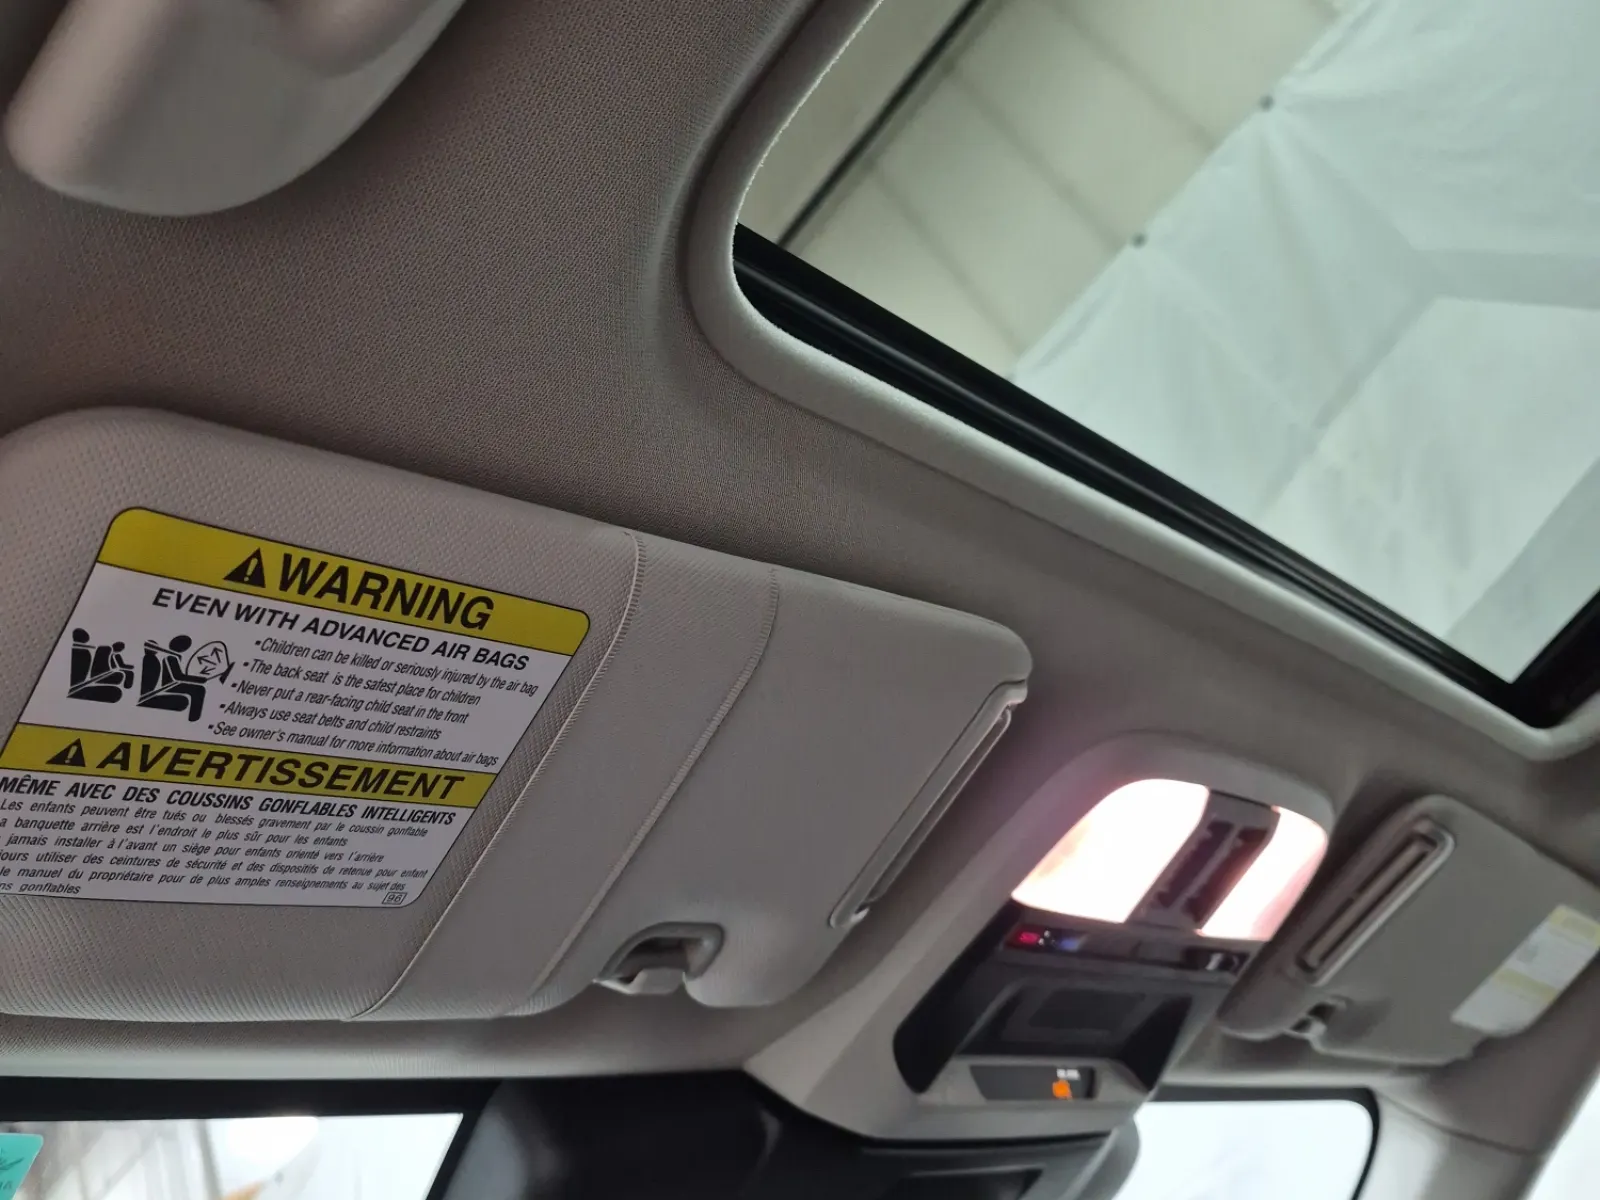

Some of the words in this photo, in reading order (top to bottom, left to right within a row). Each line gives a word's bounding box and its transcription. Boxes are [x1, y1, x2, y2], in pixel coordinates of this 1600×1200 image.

[278, 553, 495, 631] WARNING
[152, 587, 231, 619] EVEN
[234, 603, 301, 631] WITH
[301, 617, 430, 653] ADVANCED
[431, 640, 471, 661] AIR
[472, 647, 530, 671] BAGS
[250, 658, 273, 676] The
[272, 662, 304, 680] back
[302, 670, 330, 684] seat
[331, 671, 344, 686] is
[344, 674, 364, 689] the
[362, 678, 398, 694] safest
[394, 682, 426, 698] place
[425, 686, 443, 700] for
[441, 689, 482, 706] children
[260, 637, 312, 658] Children
[311, 649, 334, 662] can
[333, 650, 351, 665] be
[349, 652, 383, 670] killed
[380, 660, 396, 672] or
[393, 662, 443, 682] seriously
[440, 668, 479, 685] injured
[475, 673, 492, 690] by
[489, 676, 507, 690] the
[505, 679, 521, 692] air
[519, 681, 539, 698] bag
[223, 701, 269, 720] Always
[269, 709, 292, 722] use
[291, 712, 319, 725] seat
[316, 713, 347, 729] belts
[345, 718, 370, 732] and
[367, 720, 397, 735] child
[393, 725, 443, 741] restraints
[236, 679, 275, 697] Never
[271, 688, 296, 701] put
[294, 691, 305, 702] a
[304, 692, 366, 712] rear-facing
[364, 699, 394, 714] child
[391, 704, 416, 717] seat
[414, 705, 427, 718] in
[426, 707, 444, 721] the
[443, 709, 470, 724] front
[213, 721, 238, 737] See
[238, 727, 286, 743] owner's
[286, 732, 331, 747] manual
[328, 735, 348, 749] for
[346, 739, 376, 753] more
[374, 740, 434, 759] information
[432, 748, 464, 762] about
[461, 751, 477, 764] air
[475, 752, 499, 768] bags
[95, 741, 466, 800] AVERTISSEMENT
[0, 774, 62, 797] MÊME
[64, 782, 117, 800] AVEC
[122, 786, 161, 804] DES
[166, 789, 254, 811] COUSSINS
[258, 797, 358, 818] GONFLABLES
[360, 805, 457, 826] INTELLIGENTS
[0, 798, 24, 811] Les
[29, 801, 77, 815] enfants
[79, 805, 130, 818] peuvent
[133, 807, 158, 820] être
[162, 809, 188, 822] tués
[191, 813, 208, 823] ou
[214, 813, 255, 827] blessés
[257, 818, 313, 830] gravement
[313, 822, 333, 833] par
[335, 821, 346, 832] le
[348, 824, 385, 834] coussin
[386, 826, 429, 838] gonflable
[4, 833, 49, 847] jamais
[53, 836, 104, 849] installer
[106, 838, 116, 850] à
[161, 843, 178, 853] un
[181, 842, 212, 856] siège
[213, 846, 242, 857] pour
[244, 846, 282, 859] enfants
[285, 849, 321, 860] orienté
[323, 852, 345, 861] vers
[14, 816, 76, 832] banquette
[80, 820, 121, 834] arrière
[125, 824, 145, 835] est
[201, 828, 213, 840] le
[215, 829, 241, 841] plus
[243, 830, 264, 842] sûr
[264, 834, 292, 845] pour
[293, 834, 310, 845] les
[313, 836, 349, 847] enfants
[17, 867, 64, 879] manuel
[67, 868, 85, 880] du
[87, 870, 155, 883] propriétaire
[157, 874, 187, 885] pour
[189, 874, 204, 885] de
[206, 875, 231, 887] plus
[234, 876, 272, 888] amples
[274, 878, 349, 890] renseignements
[351, 881, 365, 890] au
[367, 881, 391, 892] sujet
[389, 881, 407, 892] des
[35, 851, 79, 864] utiliser
[82, 853, 105, 865] des
[109, 855, 162, 867] ceintures
[165, 857, 181, 869] de
[184, 858, 228, 871] sécurité
[231, 861, 244, 871] et
[246, 861, 266, 873] des
[269, 862, 320, 875] dispositifs
[322, 865, 336, 875] de
[338, 866, 373, 877] retenue
[374, 869, 399, 878] pour
[400, 868, 429, 879] enfant
[18, 882, 82, 895] gonflables
[386, 893, 406, 903] 96
